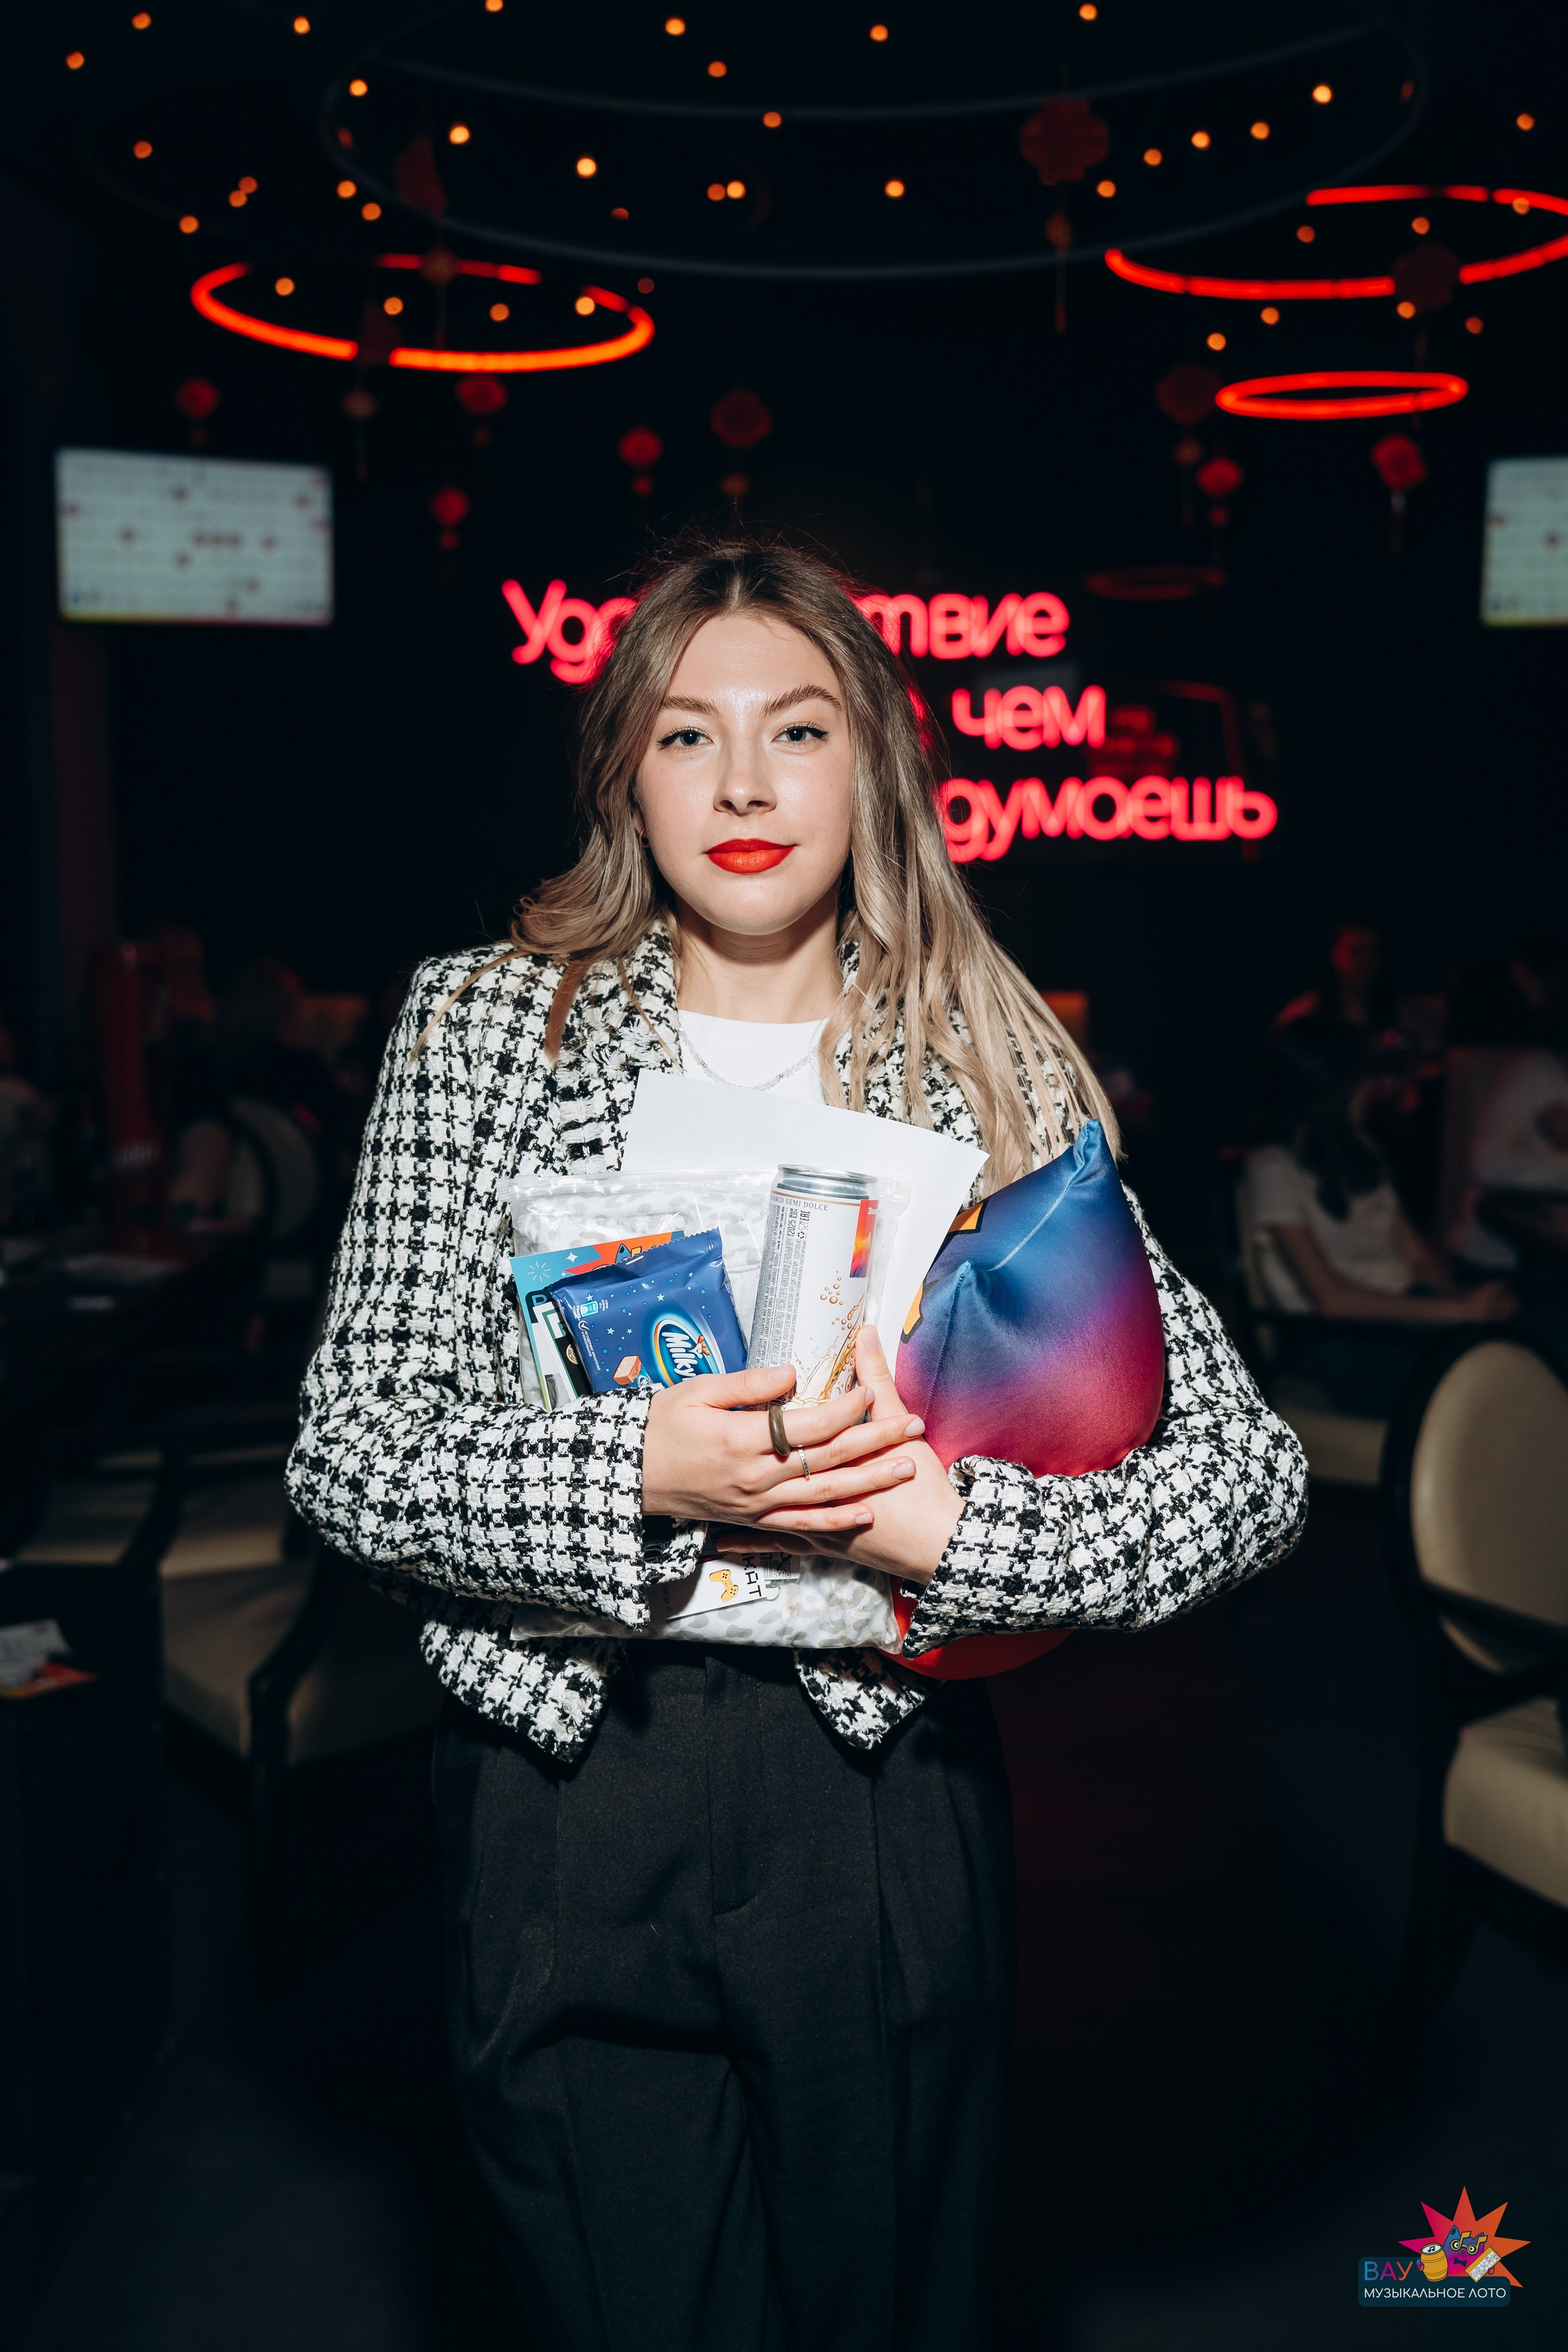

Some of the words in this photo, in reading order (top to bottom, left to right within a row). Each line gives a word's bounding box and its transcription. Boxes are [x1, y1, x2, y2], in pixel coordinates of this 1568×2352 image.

[952, 685, 1106, 751] чем
[803, 1202, 828, 1211] DOLCE
[786, 1219, 796, 1234] 2025
[662, 1332, 698, 1378] Milky
